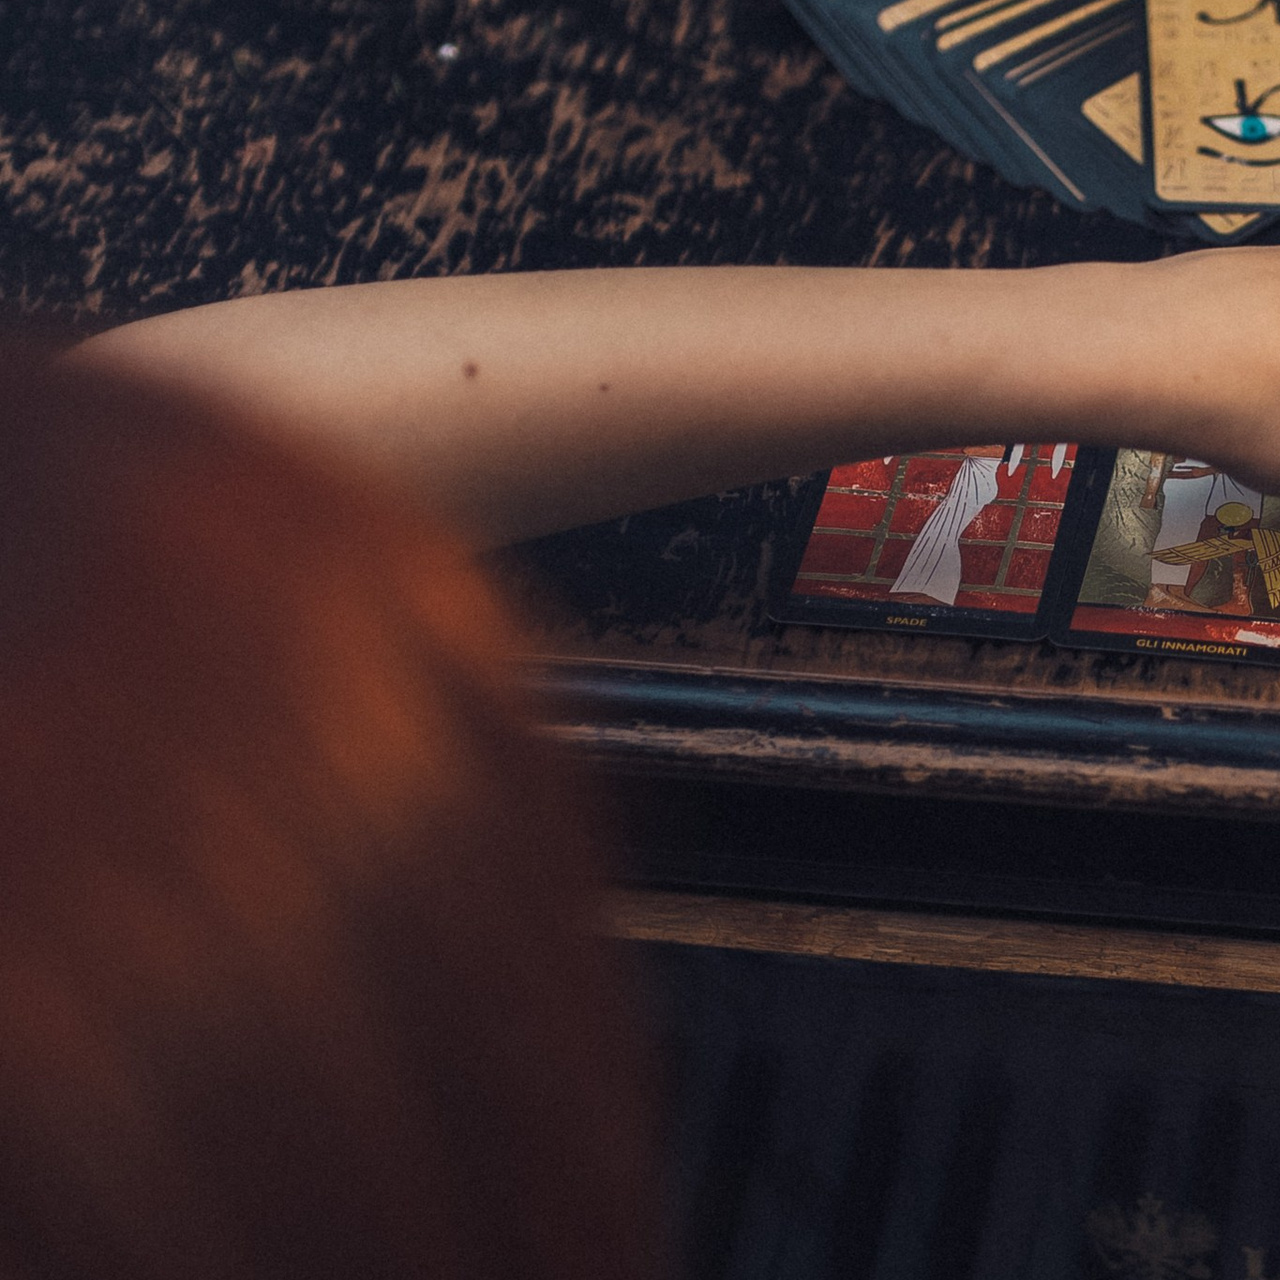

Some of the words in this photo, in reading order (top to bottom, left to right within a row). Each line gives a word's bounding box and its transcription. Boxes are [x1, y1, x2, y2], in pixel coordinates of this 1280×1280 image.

[885, 616, 928, 627] SPADE
[1135, 639, 1158, 648] GLI
[1161, 641, 1248, 657] INNAMORATI
